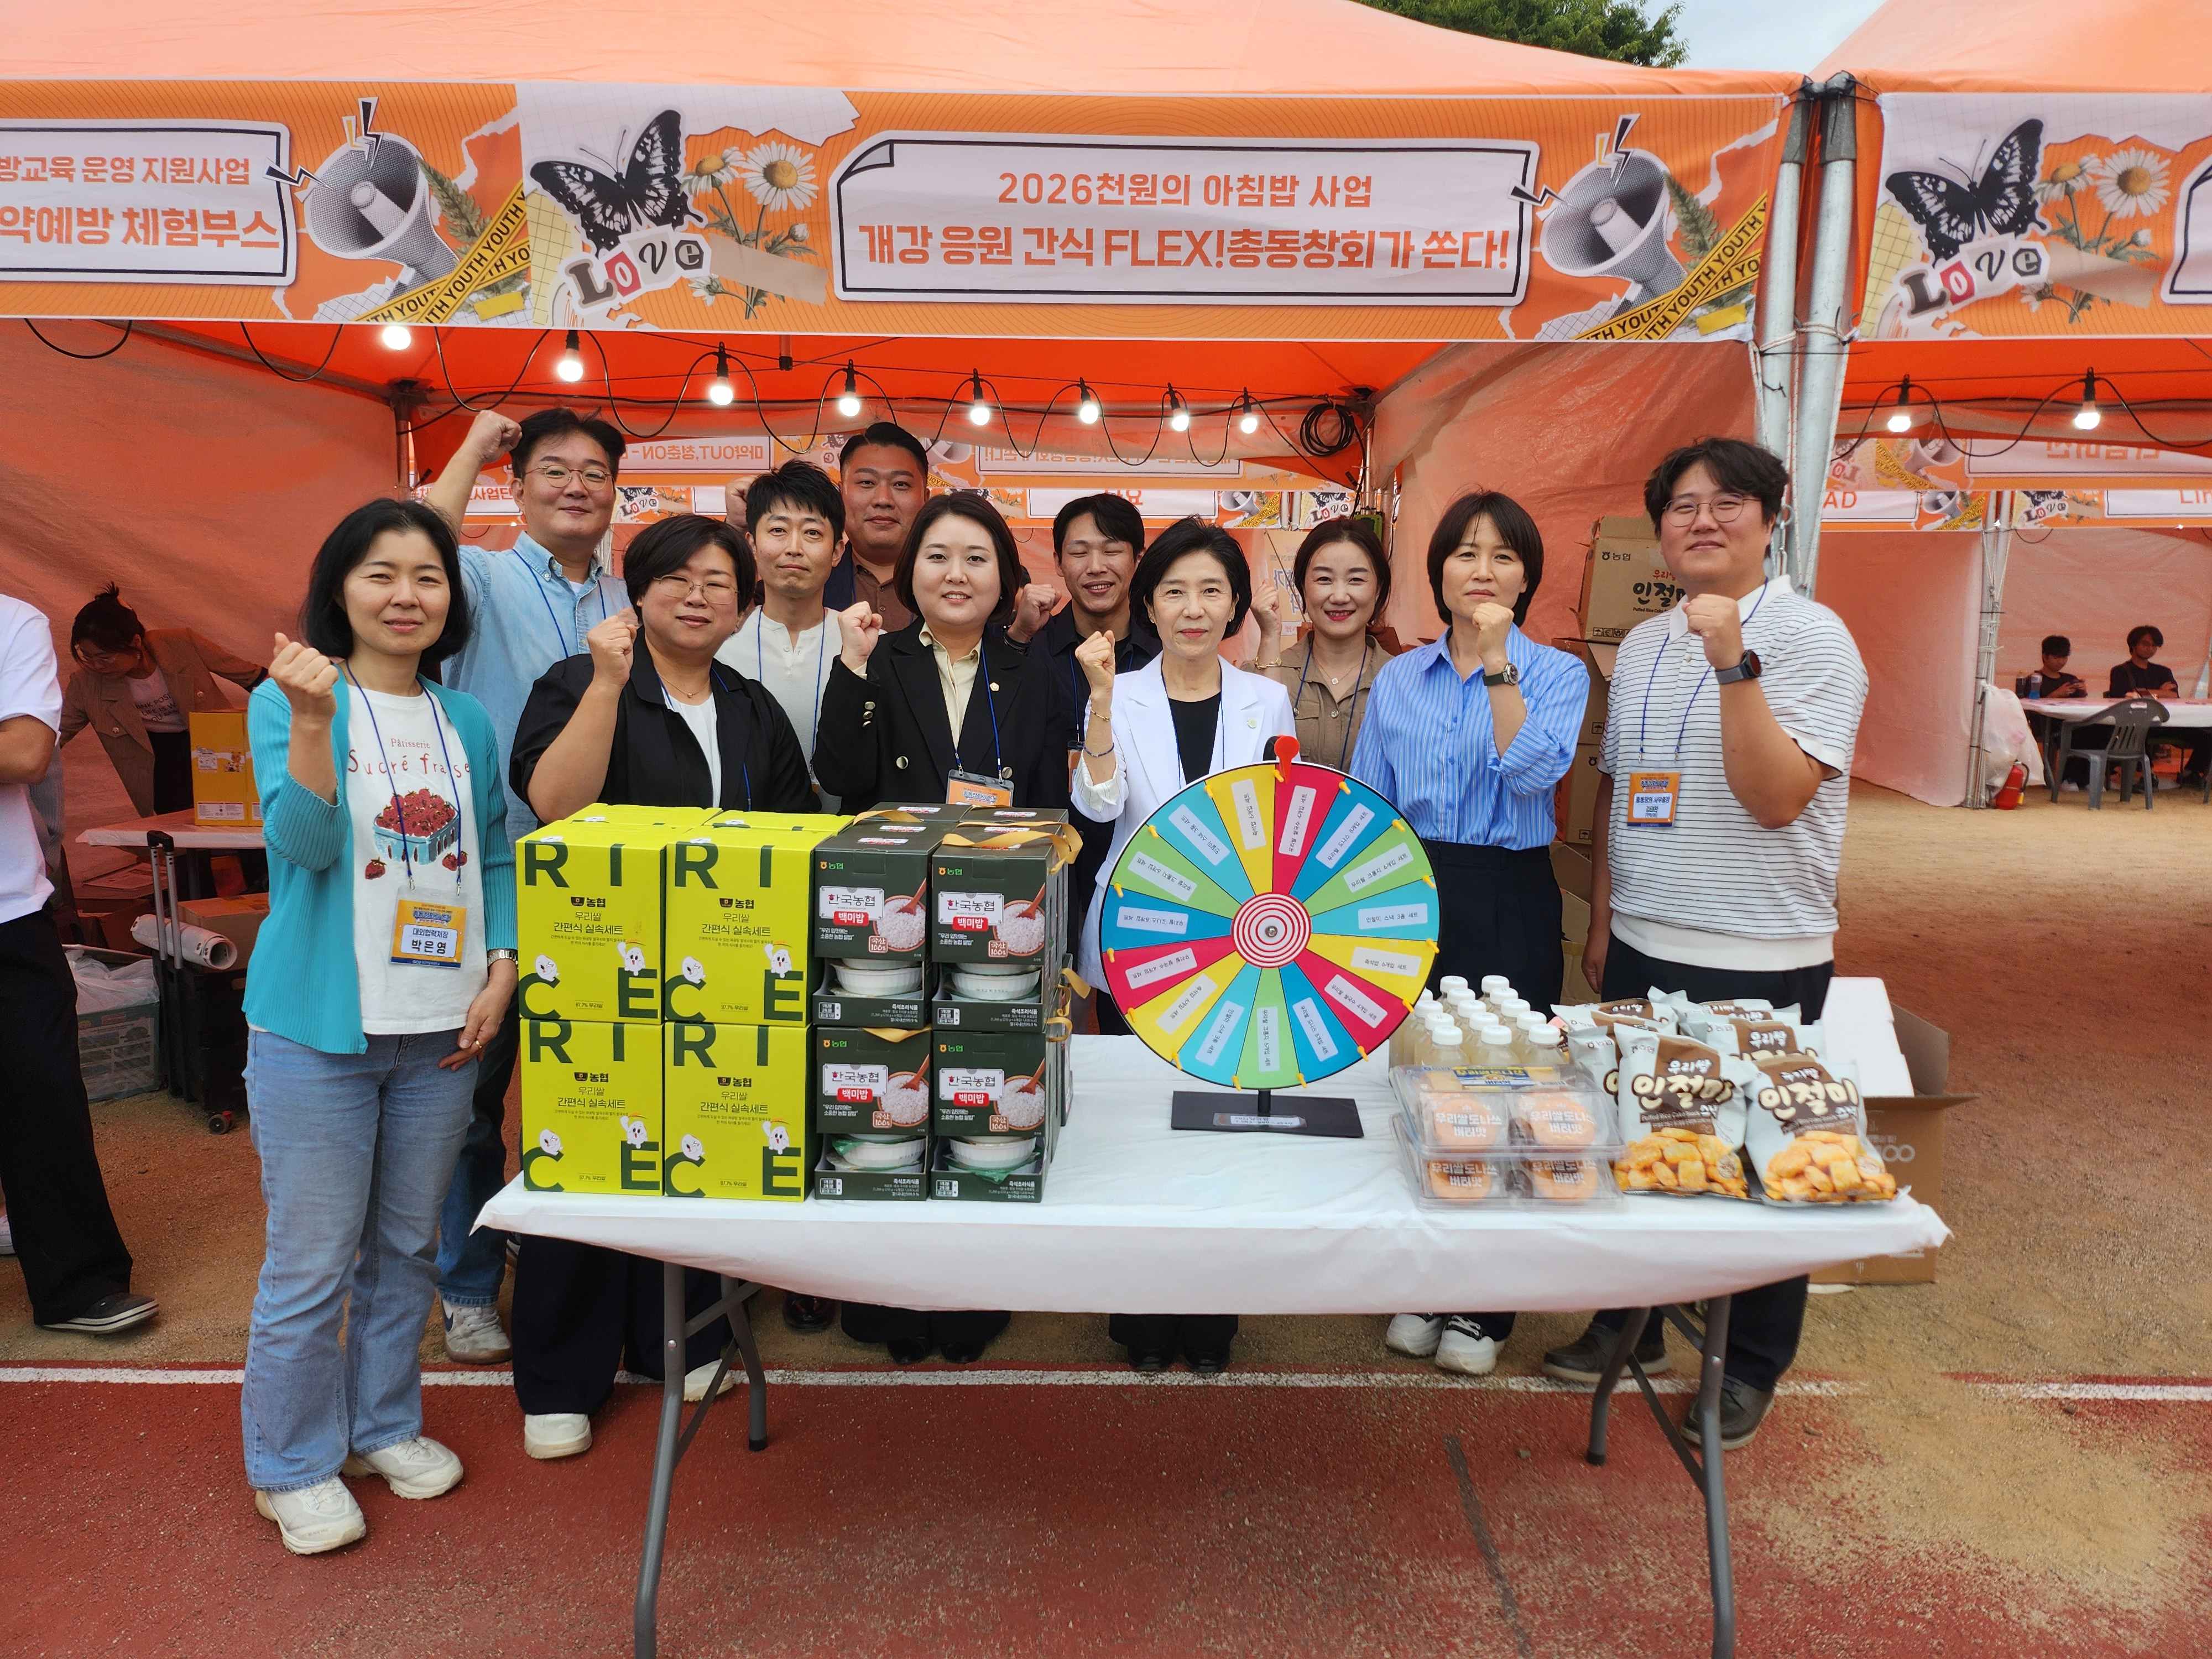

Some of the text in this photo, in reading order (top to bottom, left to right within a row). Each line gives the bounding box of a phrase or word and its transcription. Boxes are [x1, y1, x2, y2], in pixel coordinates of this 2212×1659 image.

[82, 157, 136, 184] 운영
[142, 158, 250, 186] 지원사업
[998, 173, 1372, 208] 2026천원의 아침밥 사업
[121, 207, 281, 249] 체험부스
[444, 251, 488, 301] YOUTH
[482, 202, 524, 254] YOUTH
[859, 225, 1509, 269] 개강 응원 간식 FLEX!총동창회가 쏜다!
[1668, 265, 1716, 315] YOUTH
[1713, 215, 1762, 267] YOUTH
[390, 738, 430, 749] Pâtisserie
[348, 749, 470, 778] Sucré frase
[1244, 792, 1250, 804] 세트
[1300, 794, 1307, 804] 세트
[1180, 815, 1190, 825] 세트
[1359, 811, 1368, 821] 세트
[1136, 857, 1147, 866] 세트
[587, 898, 606, 907] 농협
[735, 899, 754, 909] 농협
[828, 894, 875, 906] 한국농협
[947, 900, 995, 911] 한국농협
[575, 912, 602, 921] 우리쌀
[723, 914, 749, 923] 우리쌀
[838, 912, 865, 924] 백미밥
[554, 922, 623, 935] 간편식 실속세트
[957, 917, 984, 929] 백미밥
[413, 928, 448, 938] 대외협력처장
[702, 924, 771, 936] 간편식 실속세트
[1170, 1010, 1178, 1019] 세트
[1369, 1012, 1377, 1021] 세트
[1749, 1030, 1787, 1050] 우리쌀
[1207, 1045, 1214, 1054] 세트
[1322, 1046, 1329, 1055] 세트
[1265, 1057, 1271, 1067] 세트
[1667, 1059, 1713, 1074] 우리쌀
[590, 1072, 609, 1082] 농협
[733, 1077, 752, 1087] 농협
[832, 1071, 879, 1083] 한국농협
[948, 1076, 995, 1087] 한국농협
[578, 1087, 604, 1096] 우리쌀
[721, 1091, 748, 1101] 우리쌀
[842, 1089, 868, 1100] 백미밥
[1631, 1074, 1736, 1112] 인절미
[558, 1097, 626, 1109] 간편식 실속세트
[958, 1093, 985, 1104] 백미밥
[1758, 1078, 1859, 1122] 인절미
[701, 1102, 769, 1114] 간편식 실속세트
